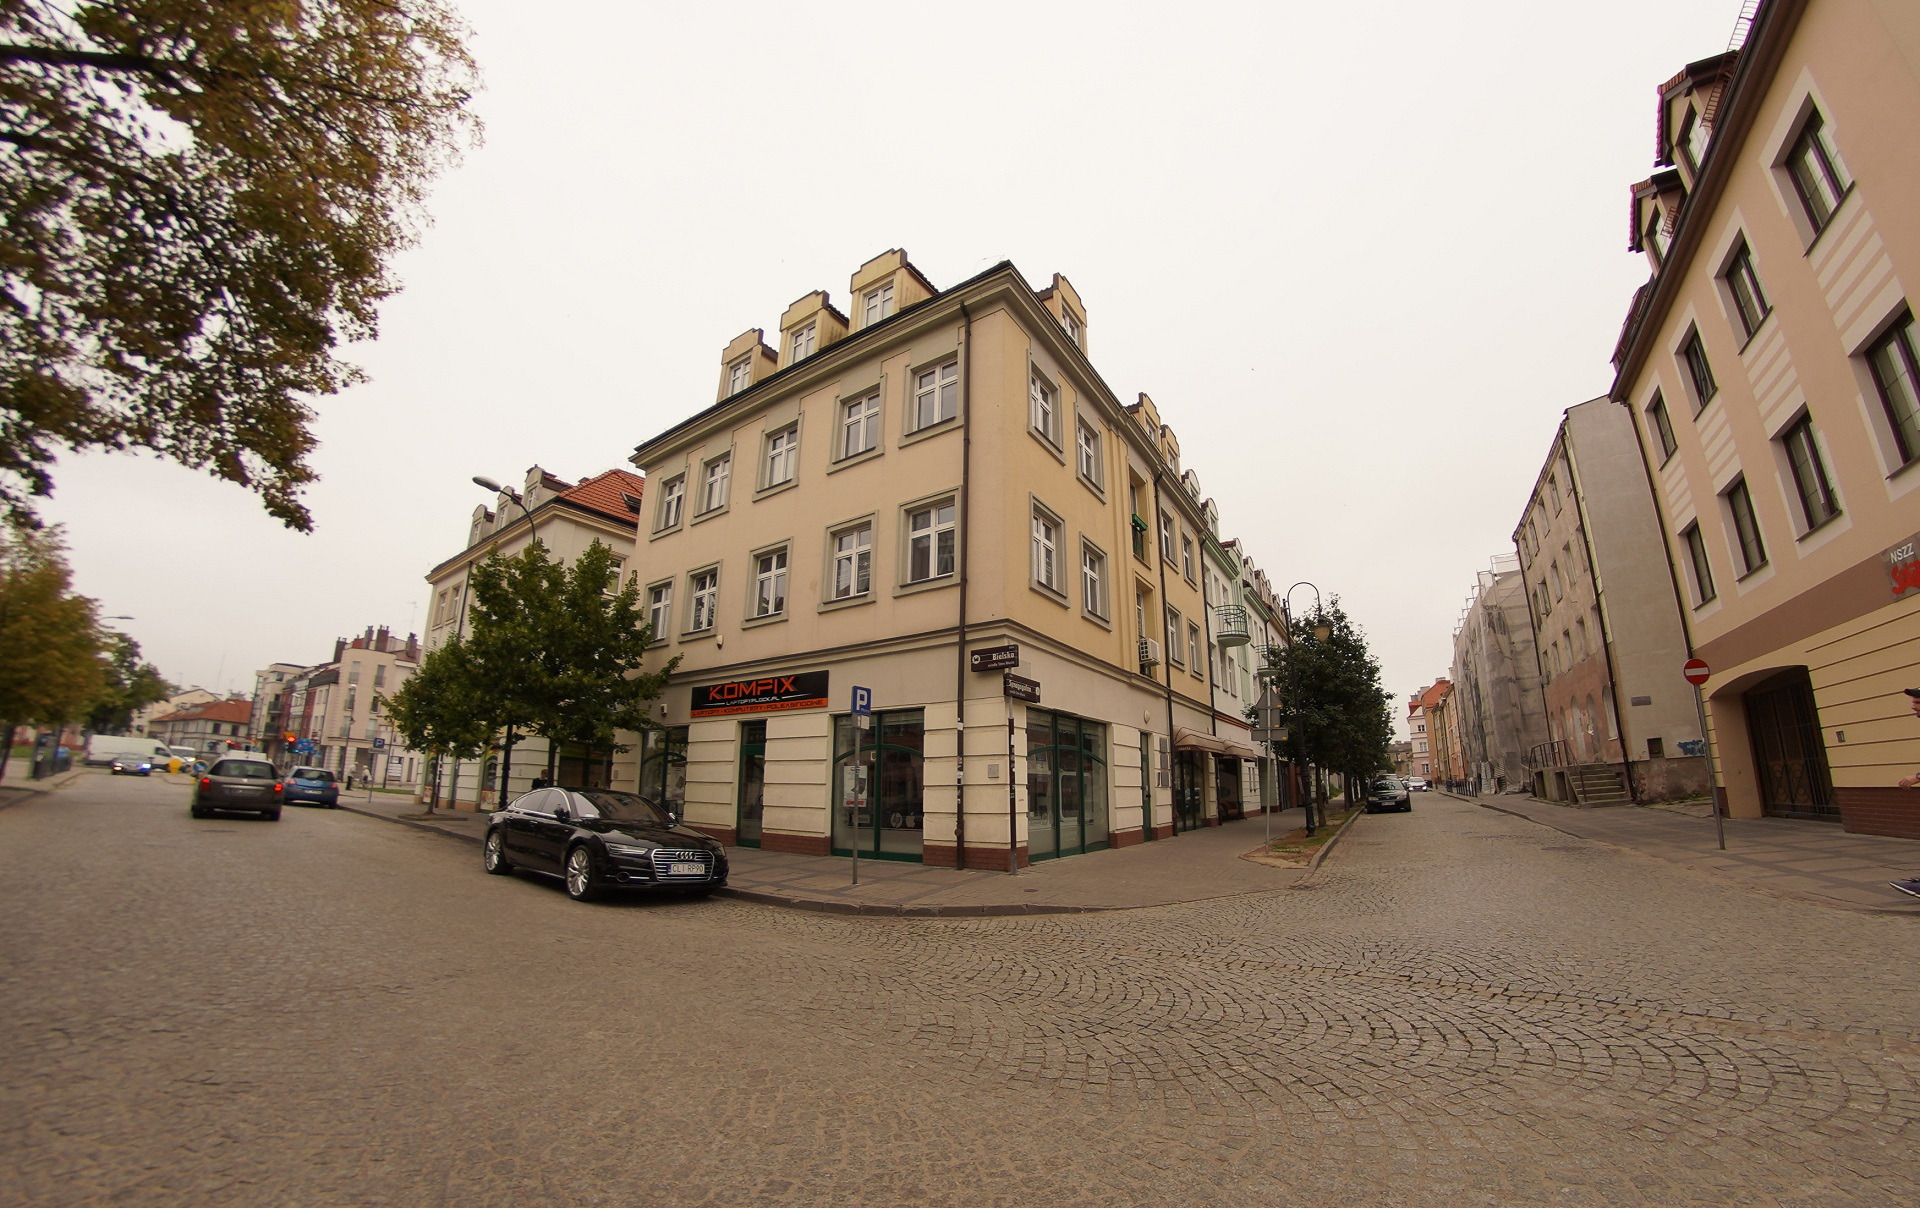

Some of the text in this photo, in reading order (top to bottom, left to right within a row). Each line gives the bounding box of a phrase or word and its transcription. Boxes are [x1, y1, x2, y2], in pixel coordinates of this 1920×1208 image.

[1890, 543, 1914, 564] NSZZ
[723, 705, 763, 713] KOMPUTERY
[856, 689, 868, 711] P
